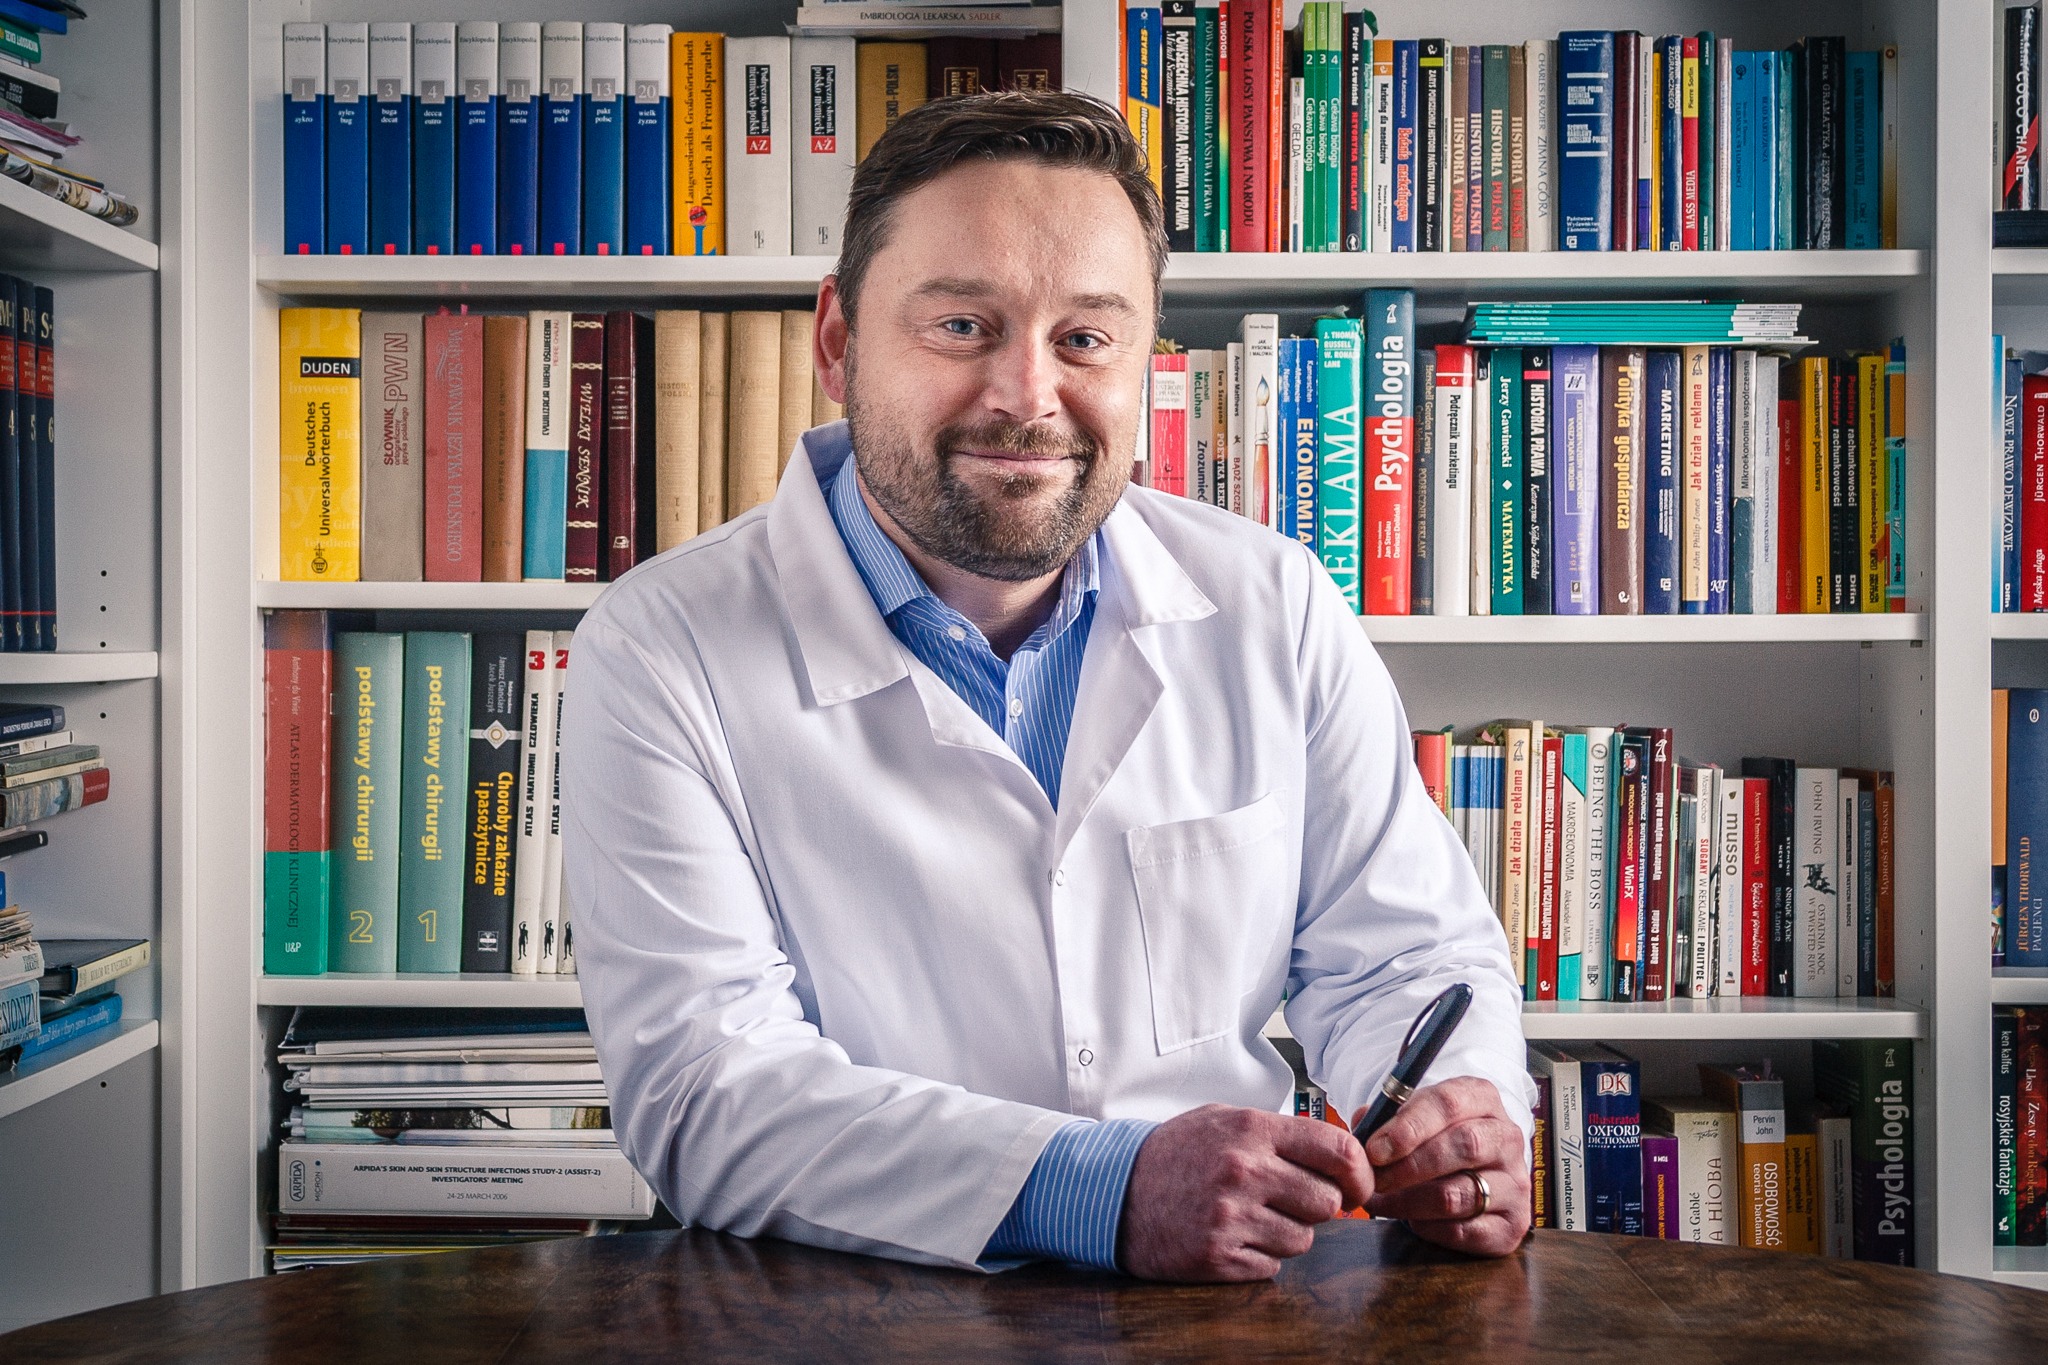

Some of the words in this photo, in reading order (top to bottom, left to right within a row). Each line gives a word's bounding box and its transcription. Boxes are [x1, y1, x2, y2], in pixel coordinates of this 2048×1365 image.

[859, 12, 920, 20] EMBRIOLOGIA
[922, 12, 966, 20] LEKARSKA
[968, 13, 1002, 21] SADLER
[1244, 11, 1255, 62] POLSKA
[1176, 31, 1189, 95] POWSZECHNA
[1306, 54, 1314, 64] 2
[1319, 55, 1327, 64] 3
[1331, 55, 1339, 64] 4
[512, 84, 526, 97] 11
[554, 83, 569, 96] 12
[597, 83, 611, 96] 13
[640, 85, 656, 98] 20
[684, 40, 696, 125] Großwörterbuch
[701, 40, 716, 130] Fremdsprache
[1244, 69, 1254, 103] LOSY
[2016, 70, 2029, 118] COCO
[1176, 96, 1189, 142] HISTORIA
[1243, 105, 1256, 163] PAŃSTWA
[1306, 98, 1314, 133] Ciekawa
[1319, 100, 1327, 132] Ciekawa
[1331, 98, 1339, 132] Ciekawa
[701, 134, 714, 152] als
[1292, 122, 1301, 157] GIEŁDA
[1305, 136, 1315, 171] biologia
[1318, 134, 1328, 163] biologia
[1330, 135, 1340, 168] biologia
[1397, 127, 1412, 160] Badania
[1453, 117, 1465, 185] HISTORIA
[1491, 109, 1503, 177] HISTORIA
[1512, 116, 1523, 184] HISTORIA
[1538, 136, 1548, 178] ZIMNA
[2016, 125, 2029, 182] CHANEL
[684, 128, 696, 204] Langenscheidts
[701, 155, 714, 207] Deutsch
[1176, 143, 1192, 188] PAŃSTWA
[1686, 170, 1696, 201] MEDIA
[1176, 195, 1189, 231] PRAWA
[1243, 174, 1254, 227] NARODU
[1395, 163, 1411, 222] marketingowe
[1453, 188, 1465, 238] POLSKI
[1491, 181, 1503, 231] POLSKI
[1512, 188, 1523, 239] POLSKI
[1538, 181, 1551, 219] GÓRA
[1686, 202, 1696, 229] MASS
[302, 362, 352, 376] DUDEN
[384, 333, 407, 402] PWN
[1742, 360, 1753, 419] współczesna
[578, 383, 593, 440] WIELKI
[1194, 371, 1202, 418] McLuhan
[1374, 336, 1411, 491] Psychologia
[1499, 376, 1511, 406] Jerzy
[1530, 384, 1544, 435] HISTORIA
[1614, 366, 1640, 428] Polityka
[1691, 384, 1702, 429] reklama
[305, 401, 316, 467] Deutsches
[384, 407, 394, 465] SŁOWNIK
[1447, 395, 1460, 440] Podręcznik
[1661, 389, 1671, 477] MARKETING
[2005, 394, 2017, 435] NOWE
[2035, 405, 2045, 461] THORWALD
[1500, 409, 1511, 468] Gawinecki
[1530, 437, 1544, 477] PRAWA
[1691, 436, 1702, 467] działa
[1742, 420, 1751, 490] Mikroekonomia
[2004, 439, 2015, 481] PRAWO
[318, 401, 330, 536] Universalwörterbuch
[576, 446, 591, 509] SENNIK
[1196, 440, 1208, 501] Zrozumieć
[1298, 418, 1312, 544] EKONOMIA
[1446, 442, 1459, 489] marketingu
[1614, 436, 1633, 530] gospodarcza
[1691, 470, 1702, 490] Jak
[2035, 464, 2045, 502] JÜRGEN
[2004, 484, 2014, 552] DEWIZOWE
[1502, 500, 1512, 595] MATEMATYKA
[529, 651, 545, 671] 3
[354, 667, 376, 769] podstawy
[423, 666, 446, 768] podstawy
[289, 724, 300, 760] ATLAS
[526, 753, 537, 802] ANATOMII
[1510, 770, 1522, 814] reklama
[1591, 765, 1603, 818] BEING
[1813, 781, 1823, 812] JOHN
[288, 763, 300, 856] DERMATOLOGII
[352, 774, 374, 861] chirurgii
[421, 773, 444, 860] chirurgii
[493, 772, 512, 834] Choroby
[525, 806, 534, 837] ATLAS
[474, 790, 490, 884] pasożytnicze
[1510, 820, 1522, 852] działa
[1565, 801, 1576, 881] MAKROEKONOMIA
[1590, 826, 1602, 862] THE
[1699, 838, 1708, 876] SLOGANY
[1726, 813, 1739, 876] musso
[1813, 815, 1823, 854] IRVING
[493, 836, 510, 897] zakaźne
[1510, 857, 1522, 876] Jak
[1624, 864, 1634, 900] WinFX
[1698, 878, 1707, 889] W
[2017, 836, 2030, 902] THORWALD
[287, 857, 298, 928] KLINICZNEJ
[1590, 869, 1602, 910] BOSS
[1698, 890, 1707, 933] REKLAMIE
[350, 911, 372, 943] 2
[418, 910, 436, 942] 1
[2017, 906, 2030, 952] JÜRGEN
[2032, 898, 2042, 952] PACJENCI
[1696, 942, 1706, 980] POLITYCE
[2001, 1031, 2012, 1048] ken
[2001, 1048, 2012, 1075] kalfus
[1601, 1074, 1627, 1090] DK
[1535, 1119, 1545, 1166] Advanced
[1588, 1125, 1640, 1136] OXFORD
[1753, 1116, 1775, 1125] Pervin
[1755, 1127, 1773, 1135] John
[1997, 1095, 2014, 1146] rosyjskie
[354, 1165, 388, 1174] ARPIDA'S
[390, 1166, 407, 1174] SKIN
[409, 1166, 424, 1174] AND
[426, 1166, 443, 1175] SKIN
[445, 1166, 486, 1175] STRUCTURE
[488, 1168, 530, 1176] INFECTIONS
[532, 1168, 562, 1176] STUDY-2
[565, 1168, 602, 1178] (ASSIST-2)
[1561, 1135, 1582, 1215] Wprowadzenie
[1754, 1163, 1762, 1193] teoria
[1875, 1080, 1911, 1236] Psychologia
[1996, 1148, 2013, 1196] fantazje
[293, 1162, 303, 1200] ARPIDA
[314, 1171, 322, 1203] MICRON
[431, 1177, 490, 1185] INVESTIGATORS'
[492, 1177, 523, 1185] MEETING
[448, 1193, 466, 1201] 24-25
[468, 1193, 492, 1202] MARCH
[494, 1194, 509, 1202] 2006
[1535, 1169, 1545, 1213] Grammar
[1566, 1218, 1574, 1229] do
[1754, 1204, 1762, 1246] badania
[1764, 1162, 1781, 1246] OSOBOWOŚĆ
